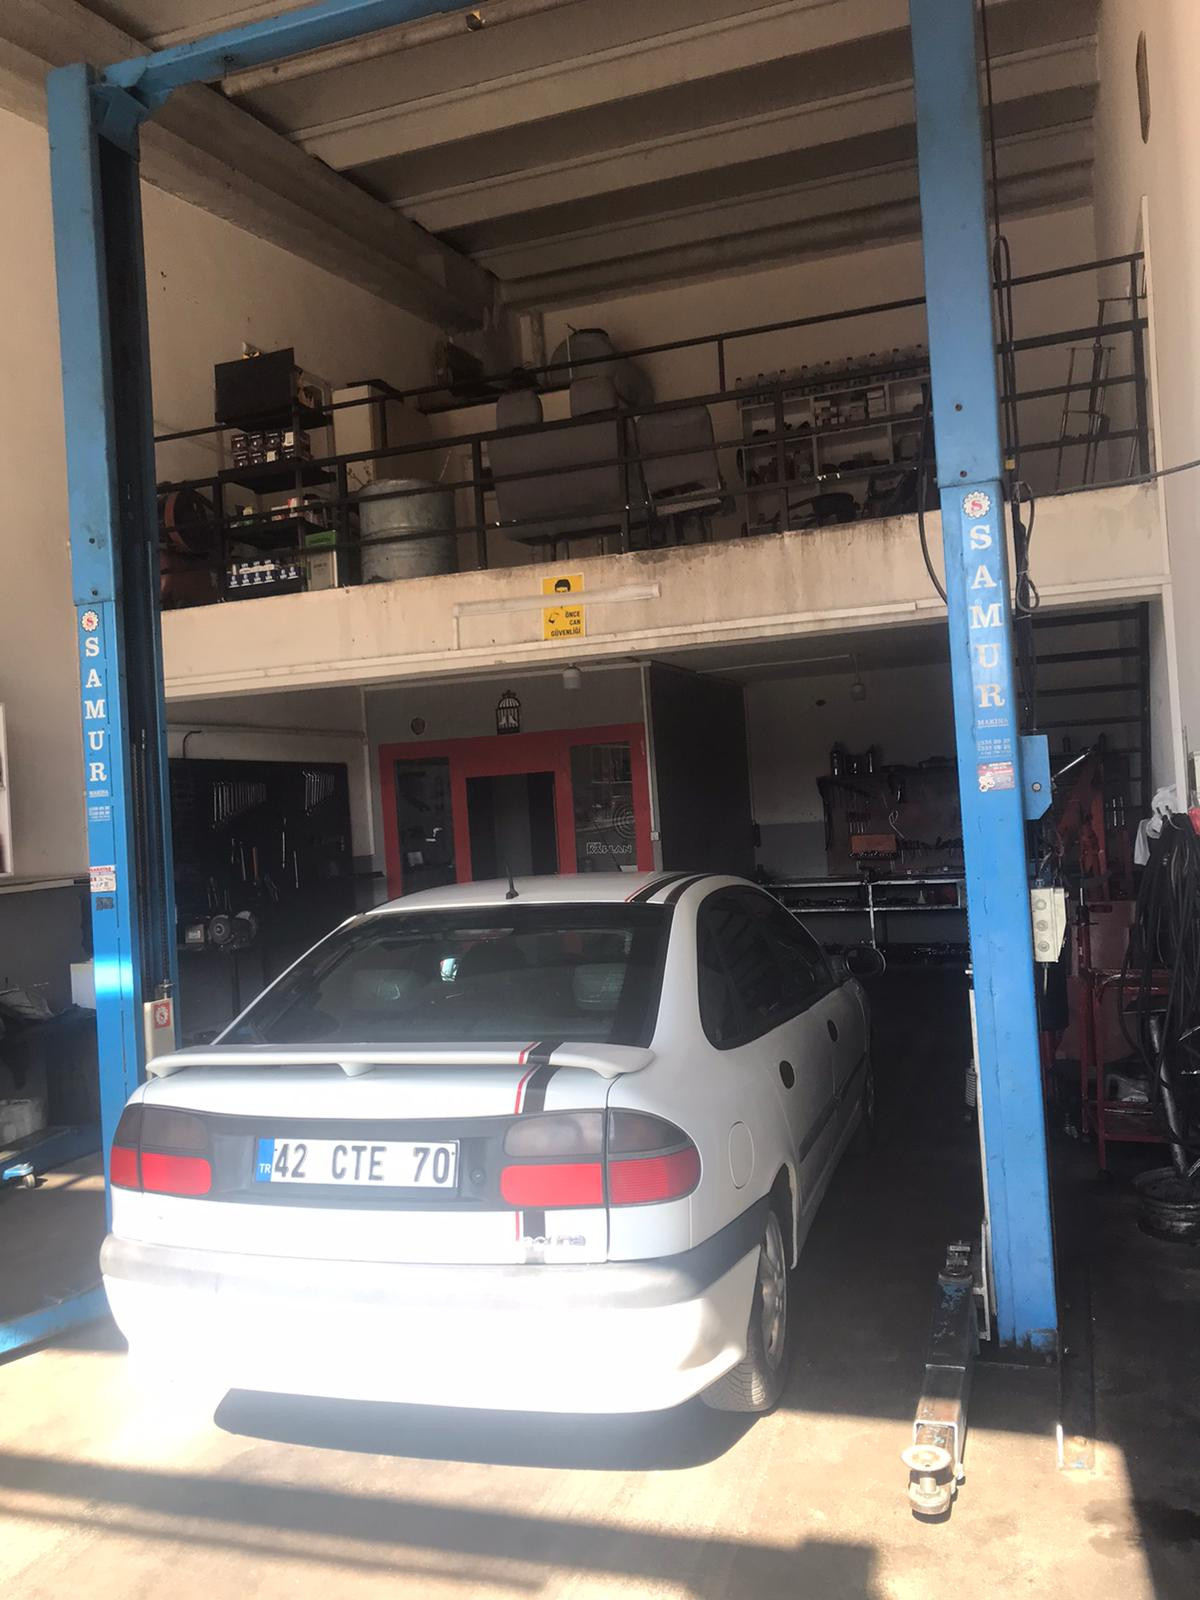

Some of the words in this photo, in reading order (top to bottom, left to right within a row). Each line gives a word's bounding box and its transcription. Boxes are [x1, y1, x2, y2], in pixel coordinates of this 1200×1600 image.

[565, 610, 580, 618] ÖNCE
[969, 524, 1005, 708] SAMUR
[84, 637, 107, 782] SAMUR
[259, 1162, 271, 1174] TR
[274, 1143, 308, 1178] 42
[331, 1144, 387, 1181] CTE
[413, 1146, 450, 1184] 70
